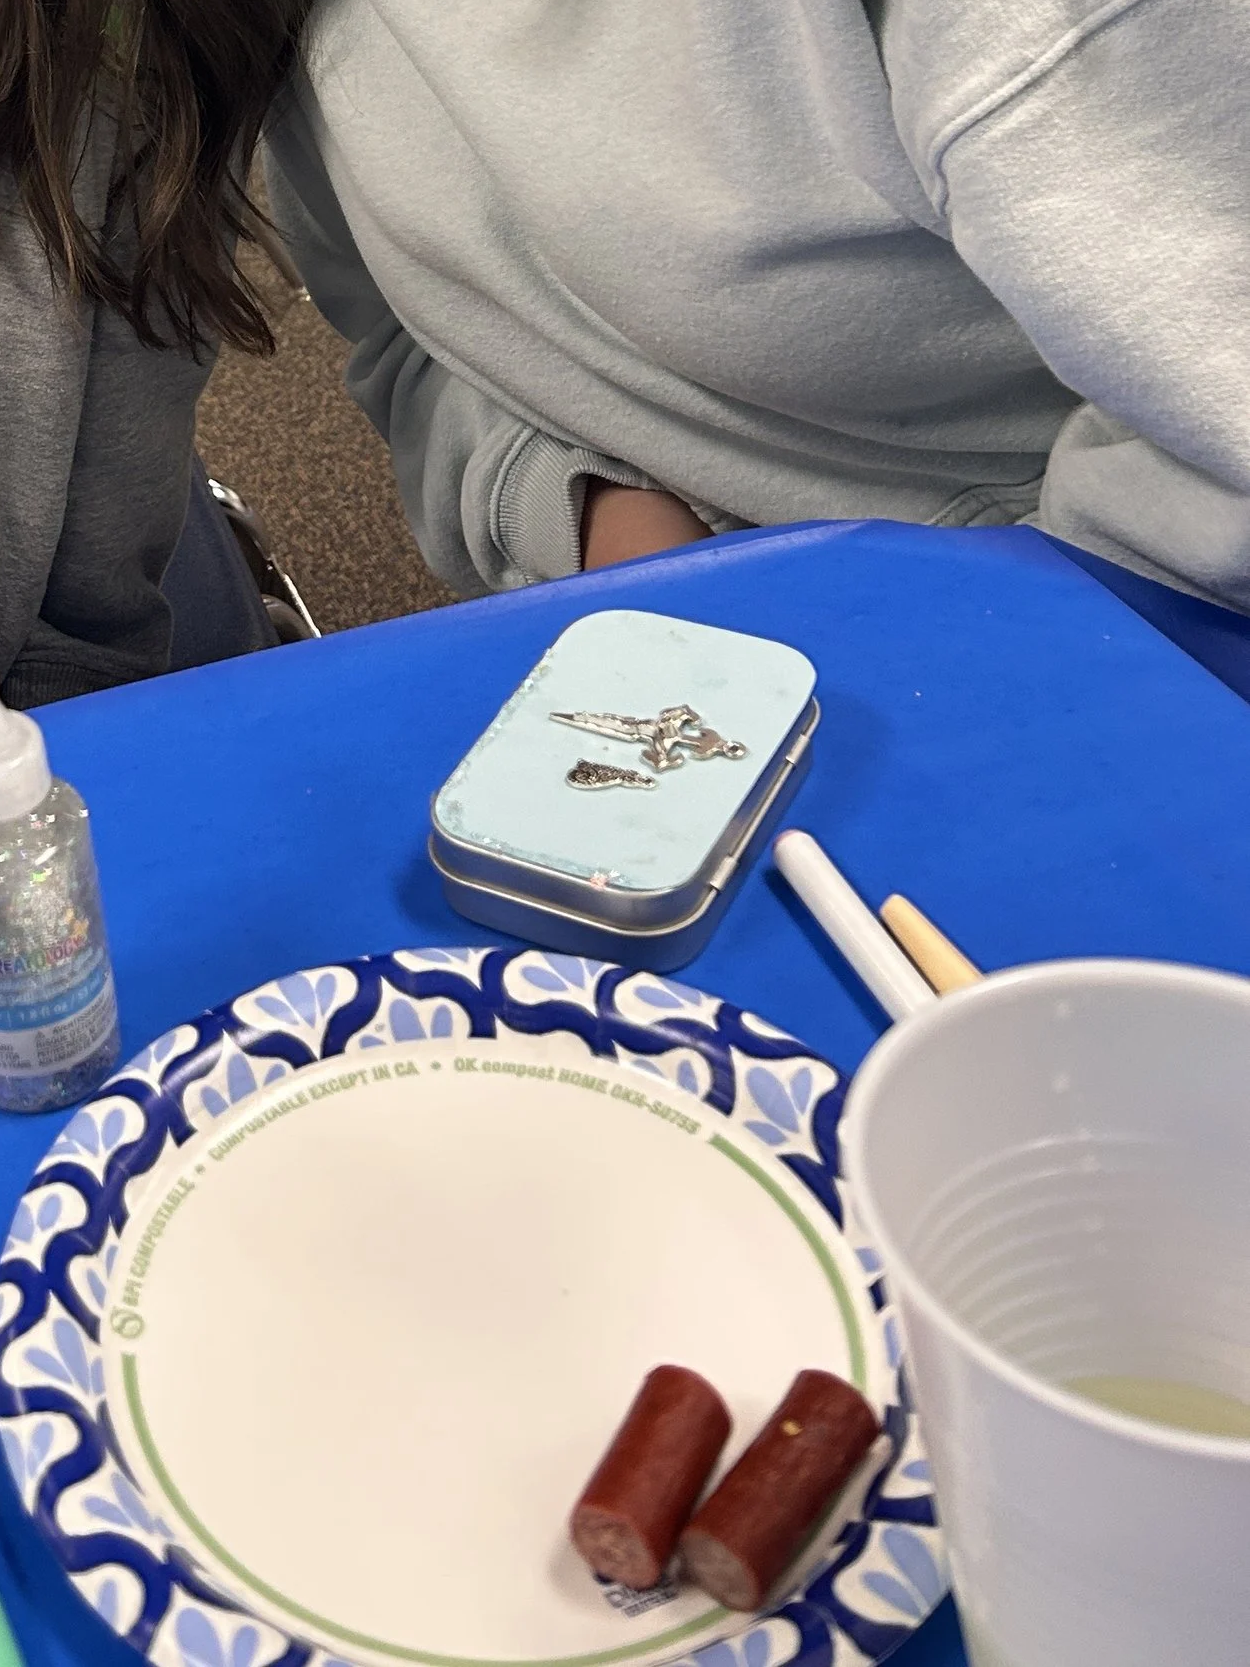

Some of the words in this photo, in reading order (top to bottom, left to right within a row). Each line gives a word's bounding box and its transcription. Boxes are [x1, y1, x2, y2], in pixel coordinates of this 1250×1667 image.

[208, 1087, 311, 1162] COMPOSTABLE
[307, 1062, 369, 1101] EXCEPT
[371, 1061, 393, 1081] IN
[394, 1060, 420, 1077] CA
[453, 1057, 480, 1072] OK
[482, 1060, 555, 1082] compost
[557, 1068, 608, 1094] HOME
[129, 1177, 196, 1278] COMPOSTABLE
